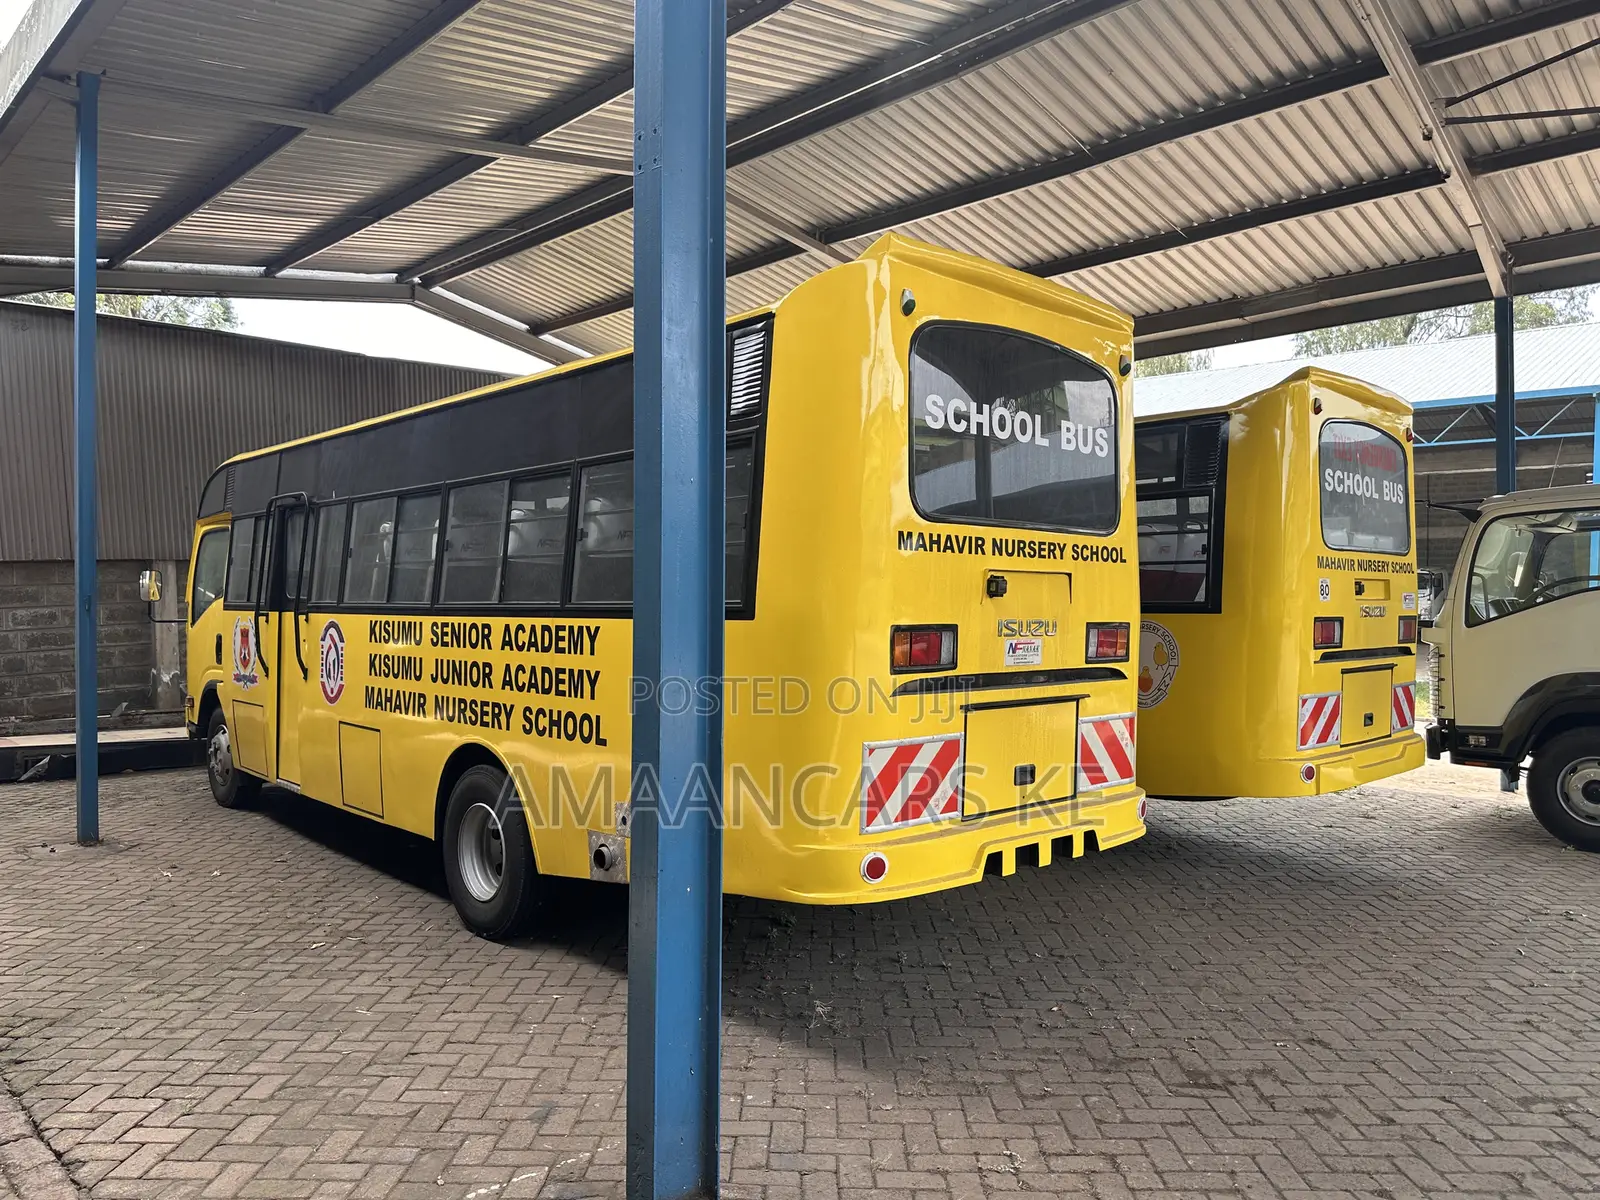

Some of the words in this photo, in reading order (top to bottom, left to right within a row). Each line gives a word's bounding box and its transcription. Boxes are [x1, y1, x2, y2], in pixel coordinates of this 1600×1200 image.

[925, 394, 1049, 447] SCHOOL
[1061, 420, 1109, 458] BUS
[1324, 468, 1379, 499] SCHOOL
[1383, 480, 1404, 505] BUS
[897, 530, 986, 555] MAHAVIR
[991, 538, 1066, 560] NURSERY
[1071, 543, 1127, 563] SCHOOL
[1317, 556, 1355, 571] MAHAVIR
[1357, 559, 1389, 573] NURSERY
[1391, 561, 1415, 574] SCHOOL
[1320, 584, 1330, 596] 80
[998, 619, 1057, 637] ISUZU
[1360, 605, 1386, 618] ISUZU
[369, 620, 423, 646] KISUMU
[430, 621, 493, 650] SENIOR
[501, 623, 601, 656] ACADEMY
[1140, 623, 1161, 634] RSERY
[1160, 631, 1177, 661] SCHOOL
[369, 653, 423, 682] KISUMU
[430, 658, 493, 689] JUNIOR
[501, 663, 601, 700] ACADEMY
[365, 685, 427, 718] MAHAVIR
[434, 694, 515, 731] NURSERY
[522, 706, 607, 747] SCHOOL
